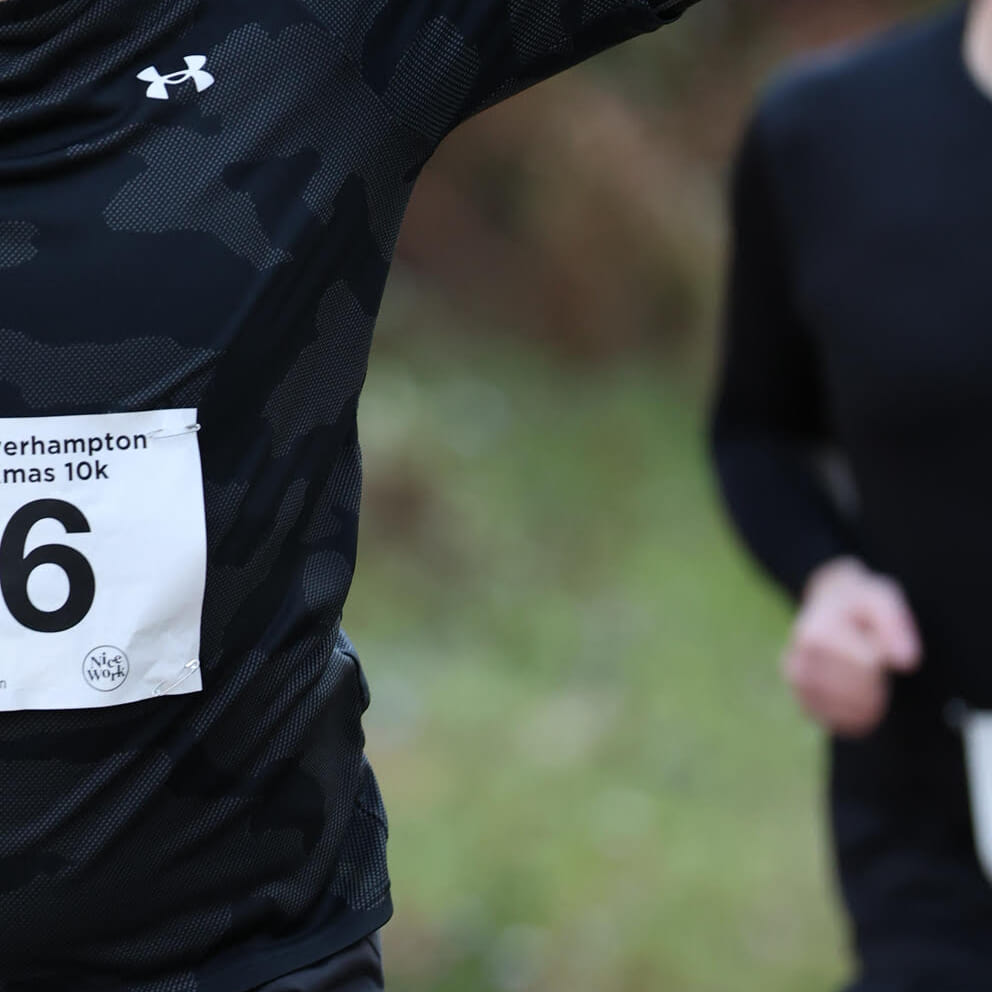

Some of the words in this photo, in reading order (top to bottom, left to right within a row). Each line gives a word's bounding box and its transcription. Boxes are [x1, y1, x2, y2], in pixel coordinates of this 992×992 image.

[64, 460, 110, 482] 10k
[90, 651, 122, 669] Nice
[87, 664, 125, 681] Work
